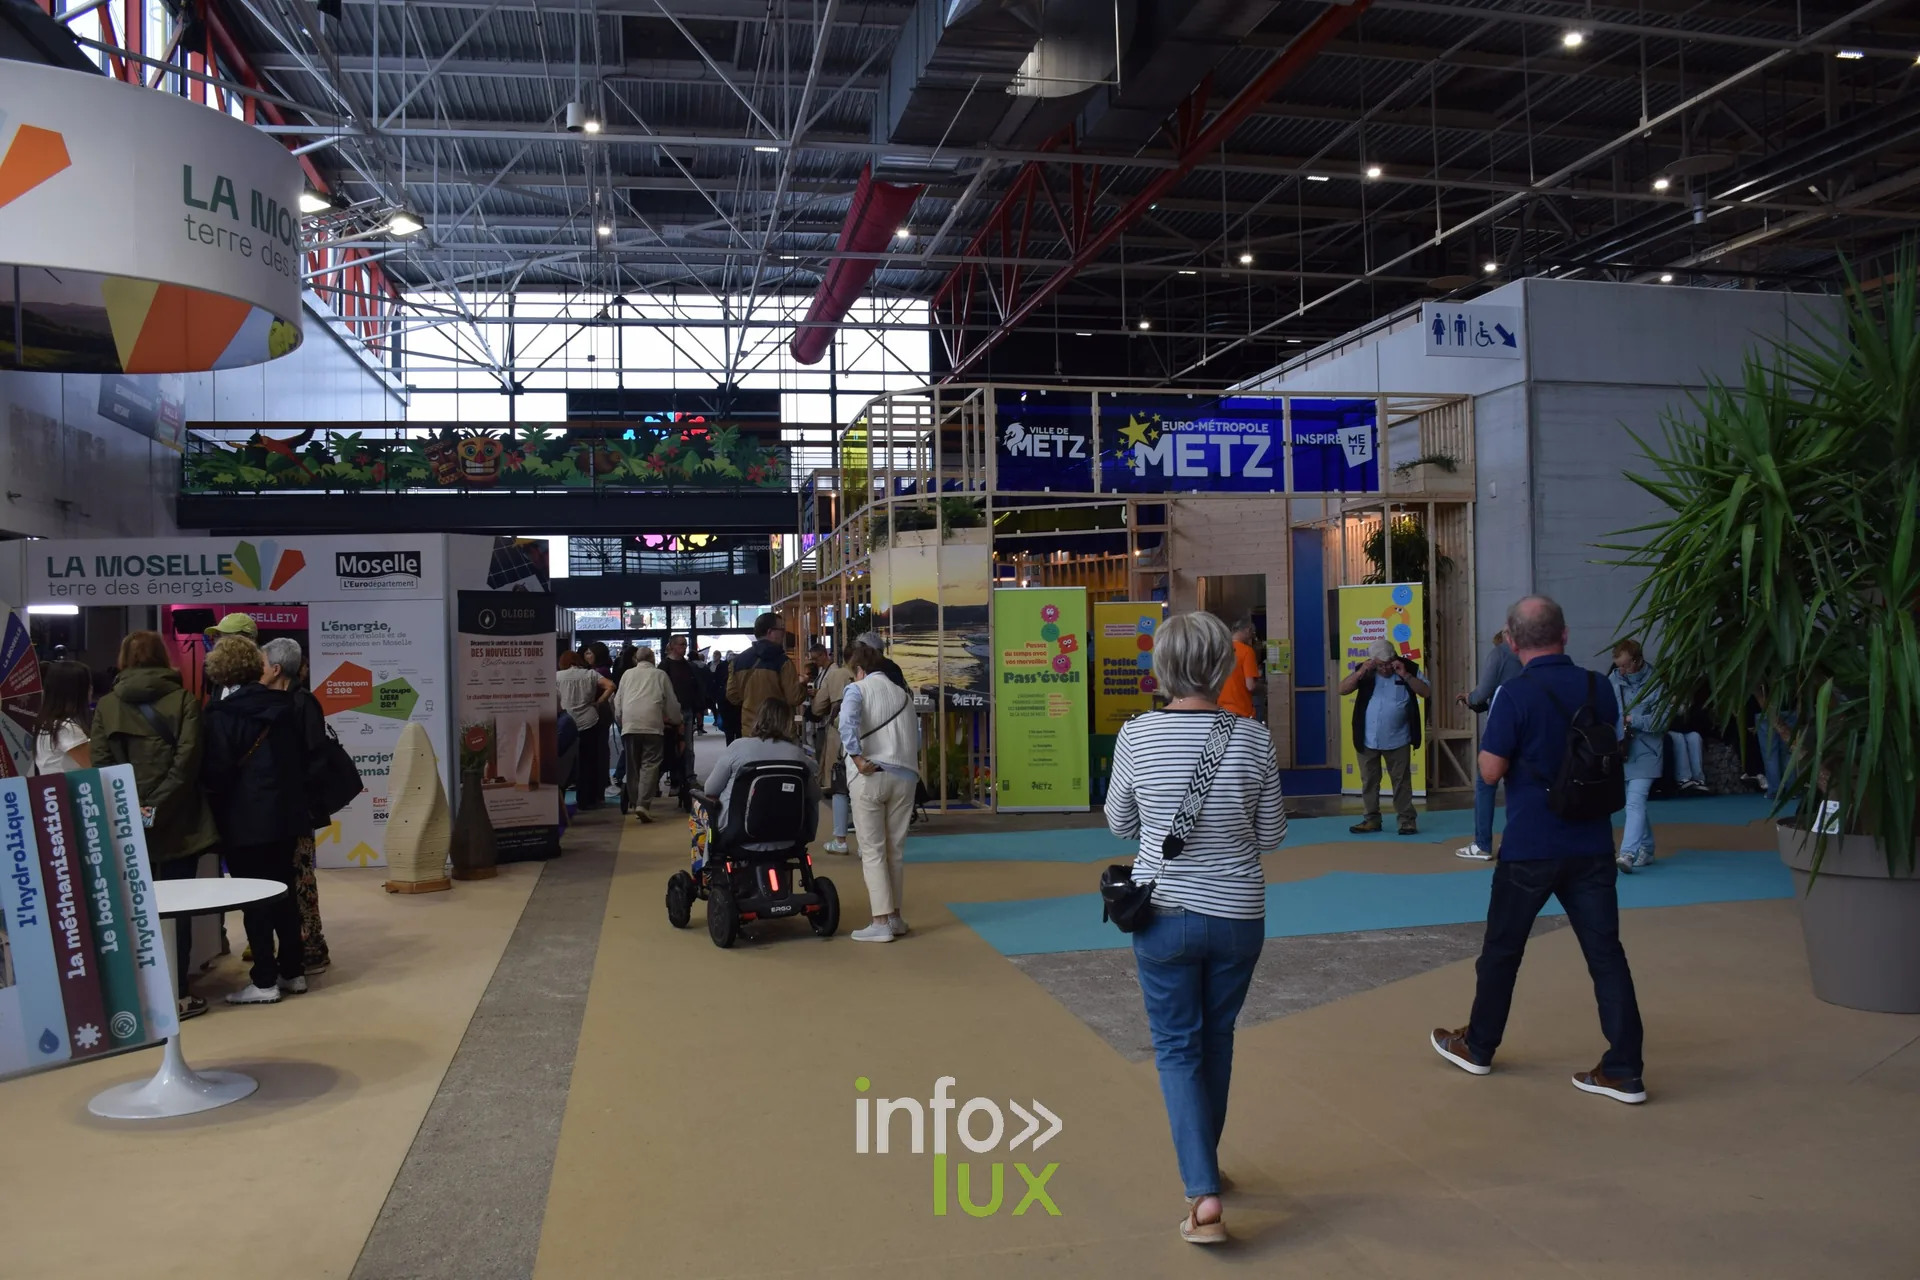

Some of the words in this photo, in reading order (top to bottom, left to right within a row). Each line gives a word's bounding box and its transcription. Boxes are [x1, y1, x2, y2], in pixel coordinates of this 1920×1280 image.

[183, 164, 239, 221] LA
[184, 214, 252, 258] terre
[261, 239, 289, 277] des
[1029, 426, 1054, 434] VILLE
[1161, 419, 1269, 433] EURO-MÉTROPOLE
[1010, 433, 1086, 458] METZ
[1348, 434, 1365, 444] ME
[1134, 433, 1273, 478] METZ
[1349, 445, 1366, 455] TZ
[47, 556, 86, 578] LA
[96, 554, 234, 577] MOSELLE
[339, 553, 418, 574] Moselle
[49, 582, 97, 597] terre
[105, 580, 140, 594] des
[147, 579, 234, 597] énergies
[344, 580, 414, 588] L'Eurodépartement
[683, 586, 692, 596] A
[248, 613, 298, 623] SELLE.TV
[501, 609, 535, 618] OLIGER
[321, 621, 392, 633] L'énergie,
[321, 634, 349, 642] moteur
[321, 641, 370, 649] compétences
[471, 648, 483, 657] DES
[485, 648, 522, 657] NOUVELLES
[524, 648, 544, 657] TOURS
[326, 680, 369, 688] Cattenom
[1003, 670, 1080, 684] Pass'éveil
[380, 688, 411, 696] Groupe
[953, 696, 984, 707] METZ
[113, 777, 133, 836] blanc
[4, 791, 38, 928] l'hydrolique
[77, 781, 114, 929] bois-énergie
[43, 786, 83, 952] méthanisation
[123, 844, 156, 970] l'hydrogène
[101, 929, 119, 955] le
[67, 952, 86, 980] la
